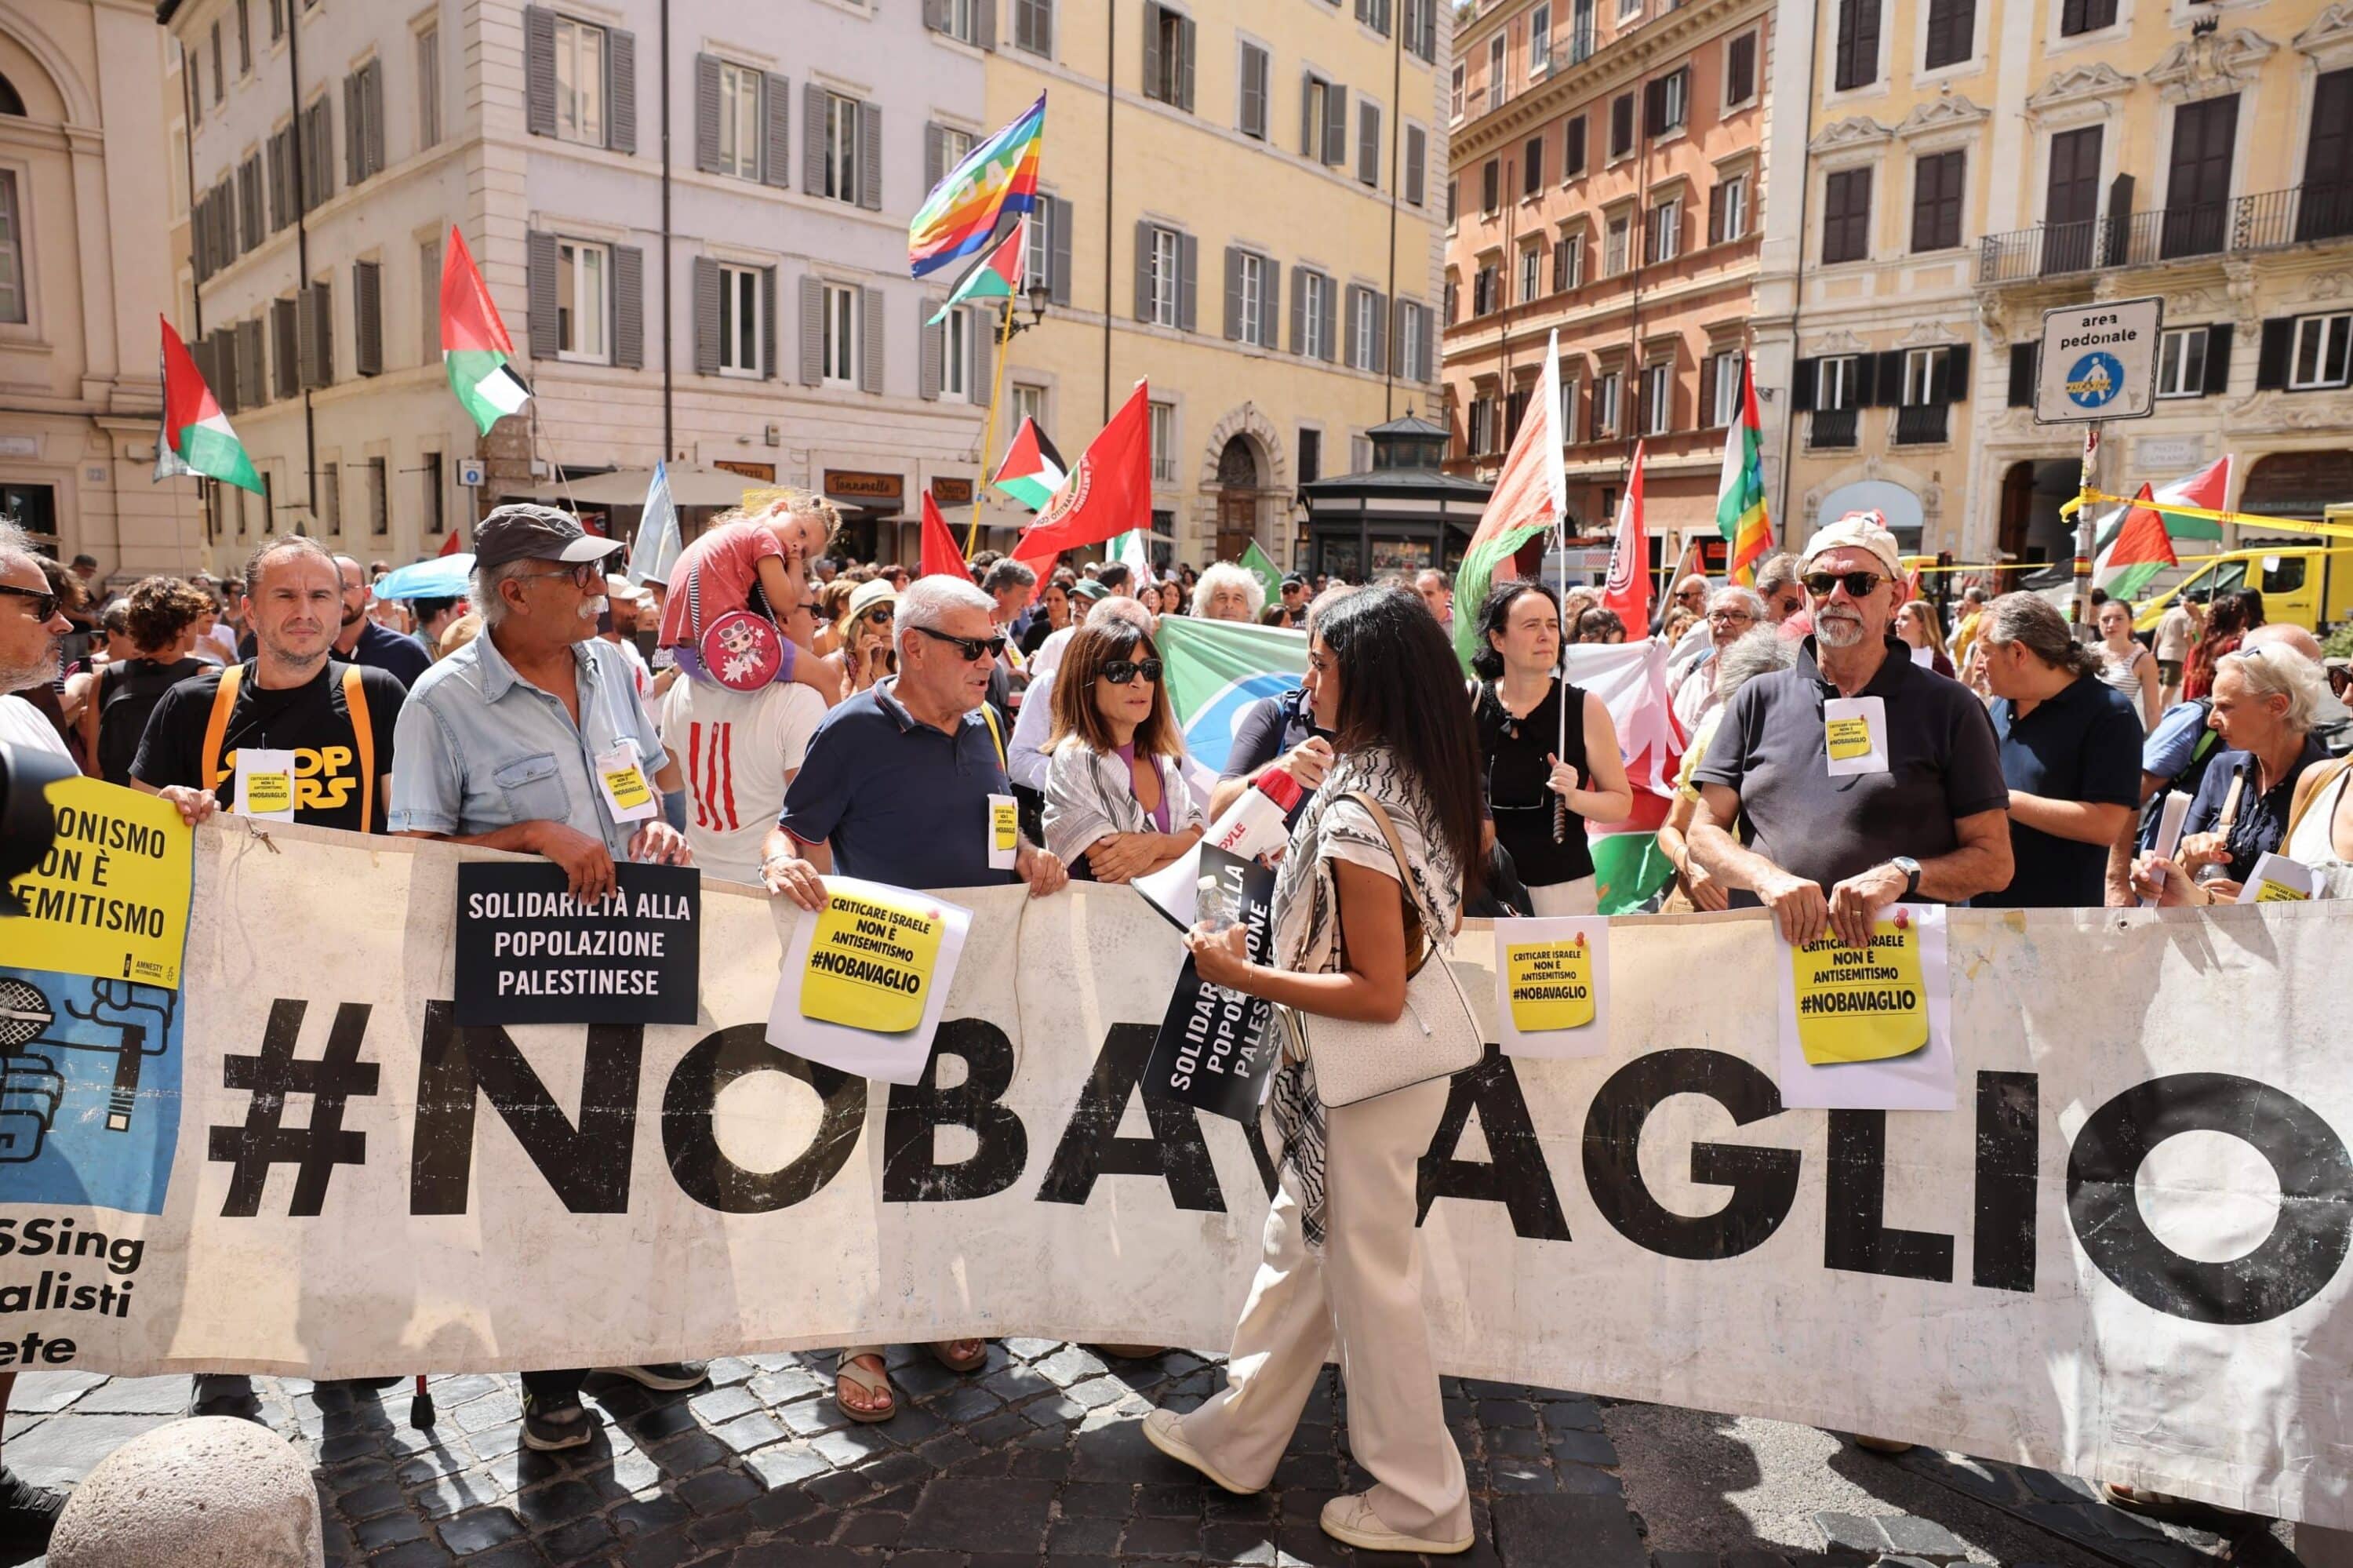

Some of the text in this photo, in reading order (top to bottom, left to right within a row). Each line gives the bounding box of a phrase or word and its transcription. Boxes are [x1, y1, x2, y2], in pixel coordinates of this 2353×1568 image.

[2082, 314, 2118, 327] area
[2060, 329, 2137, 351] pedonale
[56, 806, 165, 859] ONISMO
[37, 846, 111, 887] ON È
[16, 884, 165, 939] EMITISMO
[635, 893, 691, 921] ALLA
[831, 897, 931, 935] CRITICARE ISRAELE
[856, 919, 897, 941] NON È
[494, 930, 665, 958] POPOLAZIONE
[831, 930, 915, 962] ANTISEMITISMO
[1513, 950, 1581, 962] CRITICARE ISRAELE
[136, 960, 164, 973] AMNESTY
[1533, 959, 1562, 970] NON È
[1833, 948, 1875, 966] NON È
[497, 970, 660, 996] PALESTINESE
[811, 951, 920, 995] #NOBAVAGLIO
[1521, 971, 1577, 981] ANTISEMITISMO
[1813, 967, 1898, 984] ANTISEMITISMO
[1513, 985, 1587, 1000] #NOBAVAGLIO
[1801, 990, 1916, 1014] #NOBAVAGLIO
[1170, 981, 1218, 1091] SOLIDAR
[209, 999, 2353, 1325] #NOBAAGLIO
